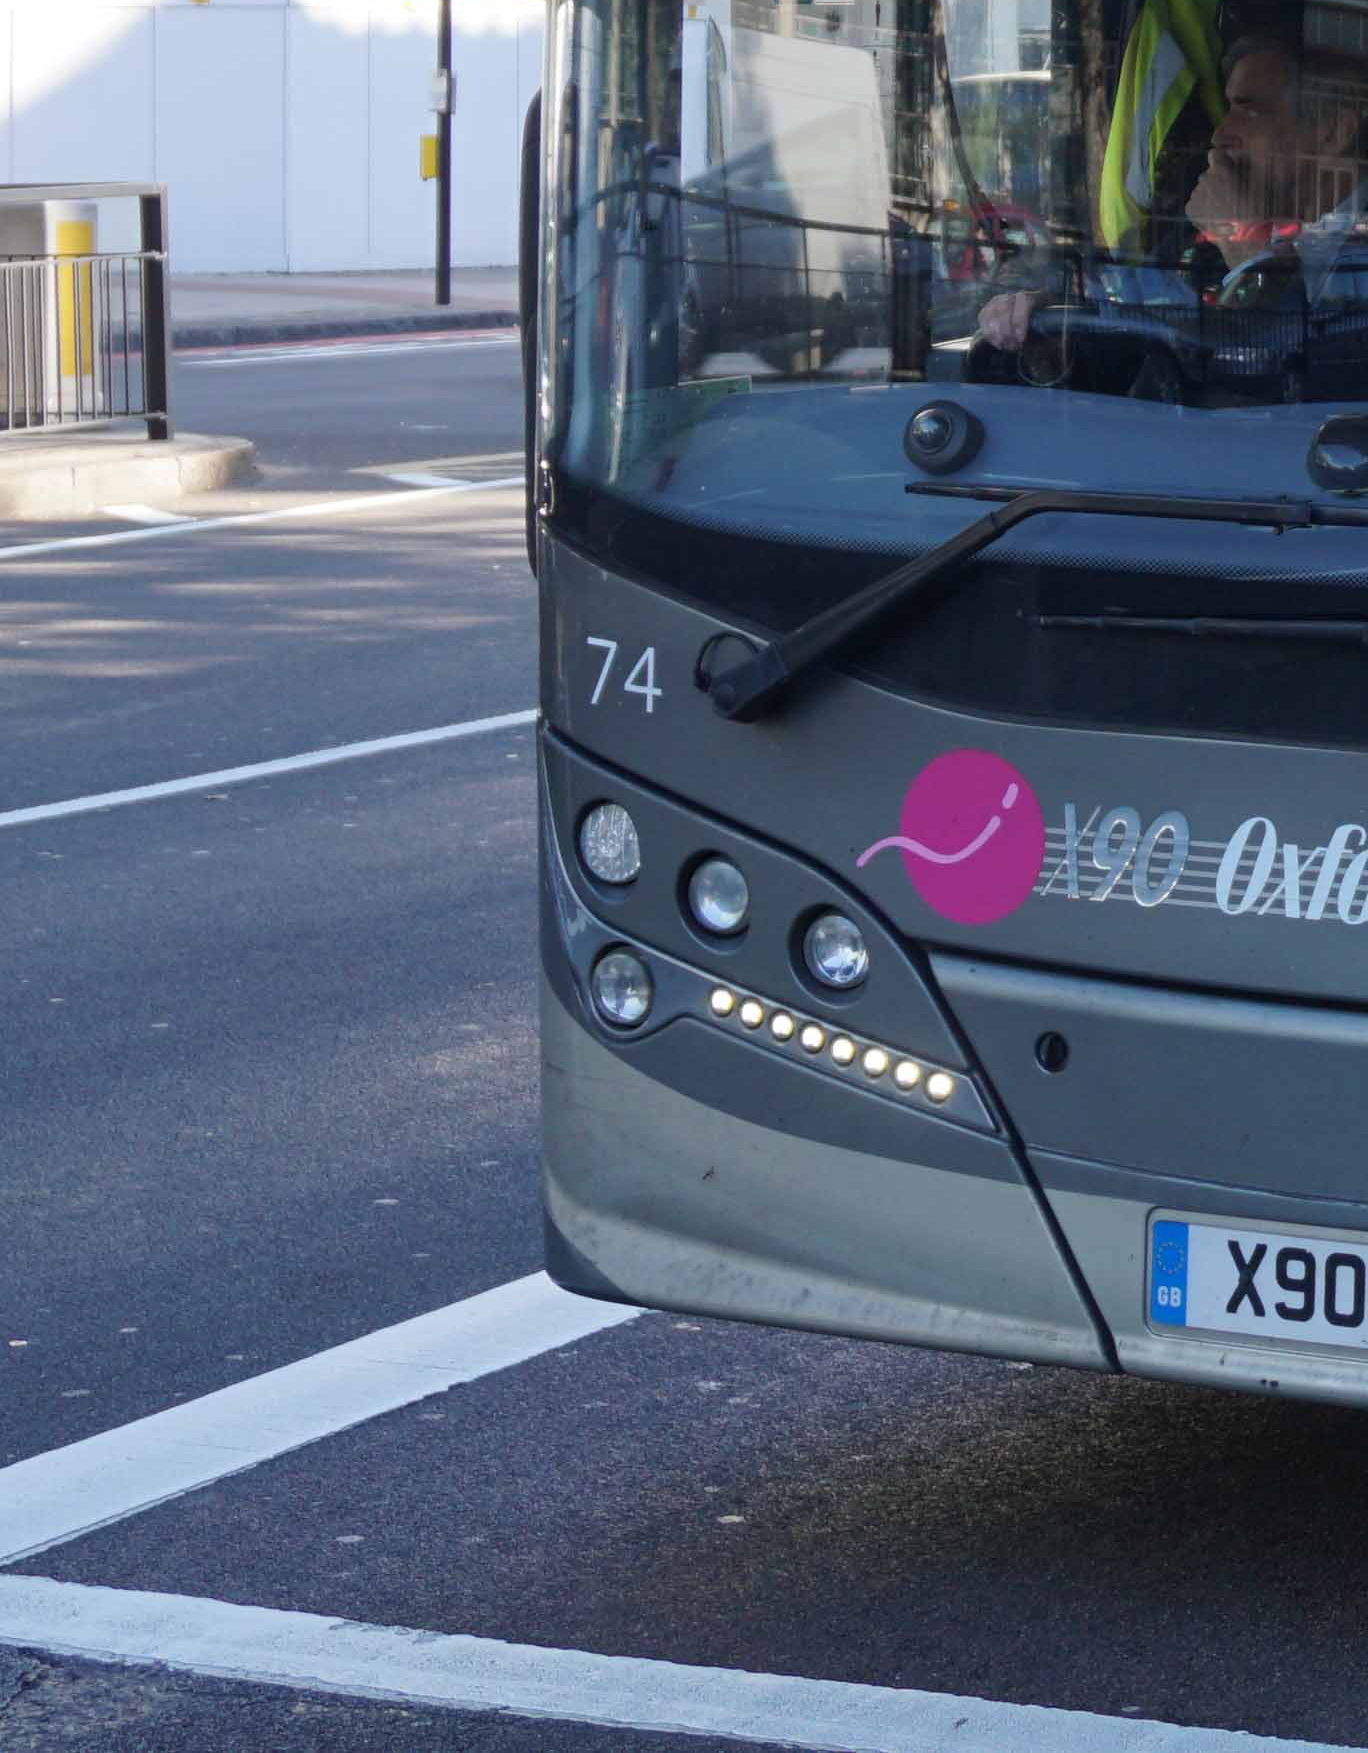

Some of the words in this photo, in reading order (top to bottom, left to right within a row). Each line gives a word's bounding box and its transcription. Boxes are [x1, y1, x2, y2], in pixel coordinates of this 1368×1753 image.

[585, 636, 663, 713] 74
[1040, 800, 1192, 909] X90
[1156, 1284, 1182, 1308] GB
[1225, 1239, 1367, 1329] X90
